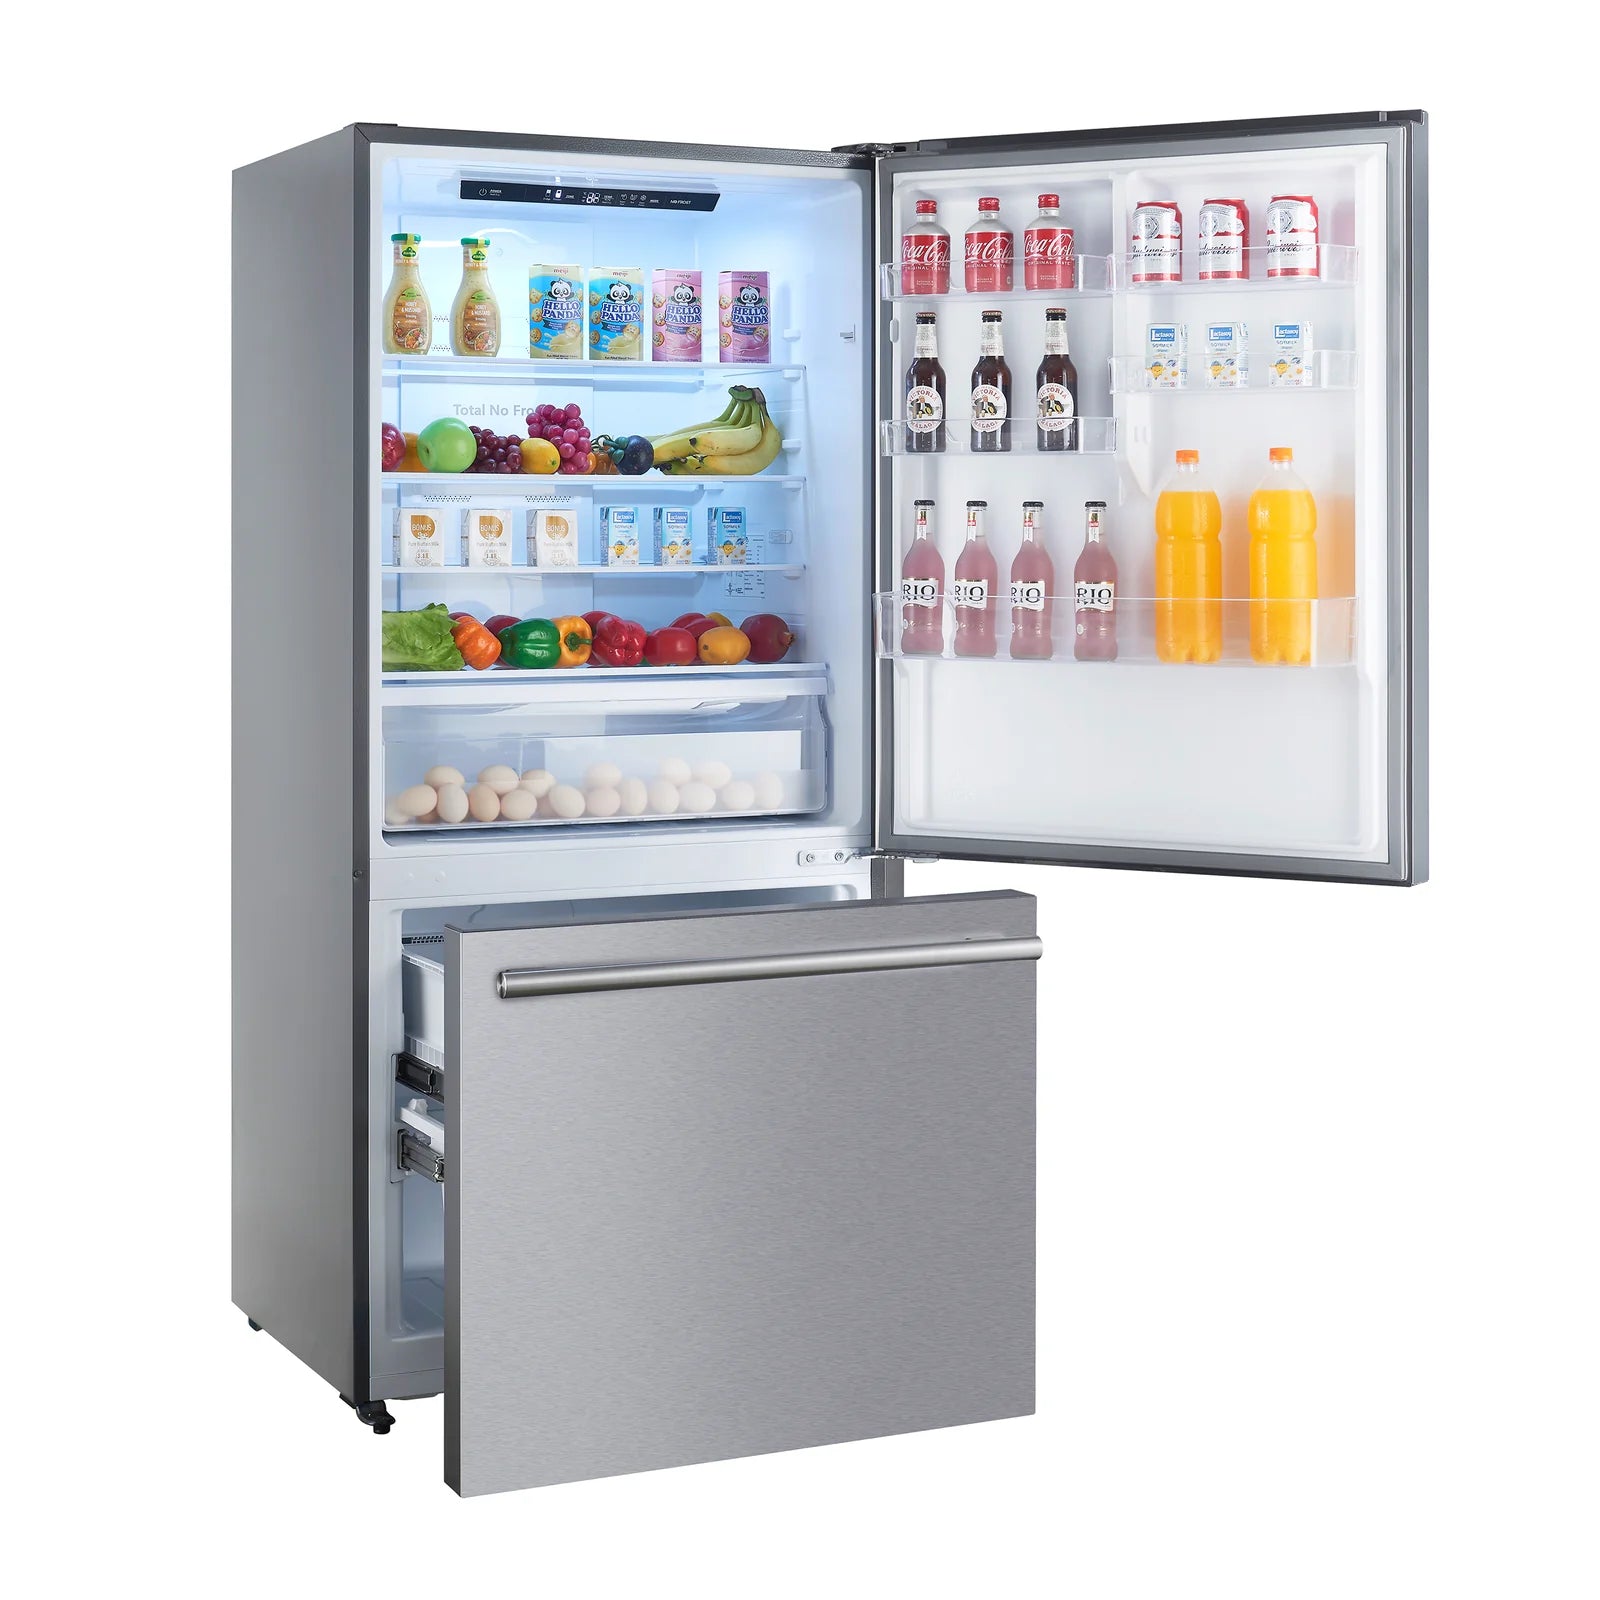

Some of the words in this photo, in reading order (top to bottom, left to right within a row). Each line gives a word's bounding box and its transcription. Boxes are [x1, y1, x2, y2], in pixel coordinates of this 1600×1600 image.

[543, 300, 580, 311] HELLO
[602, 303, 638, 313] HELLO
[667, 305, 701, 315] HELLO
[543, 309, 581, 319] PANDA
[734, 306, 768, 316] HELLO
[601, 312, 639, 321] PANDA
[666, 314, 701, 323] PANDA
[733, 315, 768, 324] PANDA
[1151, 329, 1175, 341] Lactasoy
[1210, 329, 1232, 340] Lactasoy
[1275, 326, 1299, 338] Lactasoy
[453, 403, 485, 416] Total
[490, 404, 509, 416] No
[513, 404, 535, 416] Fro
[412, 523, 432, 531] BONUS
[480, 524, 500, 532] BONUS
[903, 584, 936, 601] RIO
[955, 585, 984, 602] RIO
[1011, 587, 1041, 603] RIO
[1077, 588, 1112, 605] RIO
